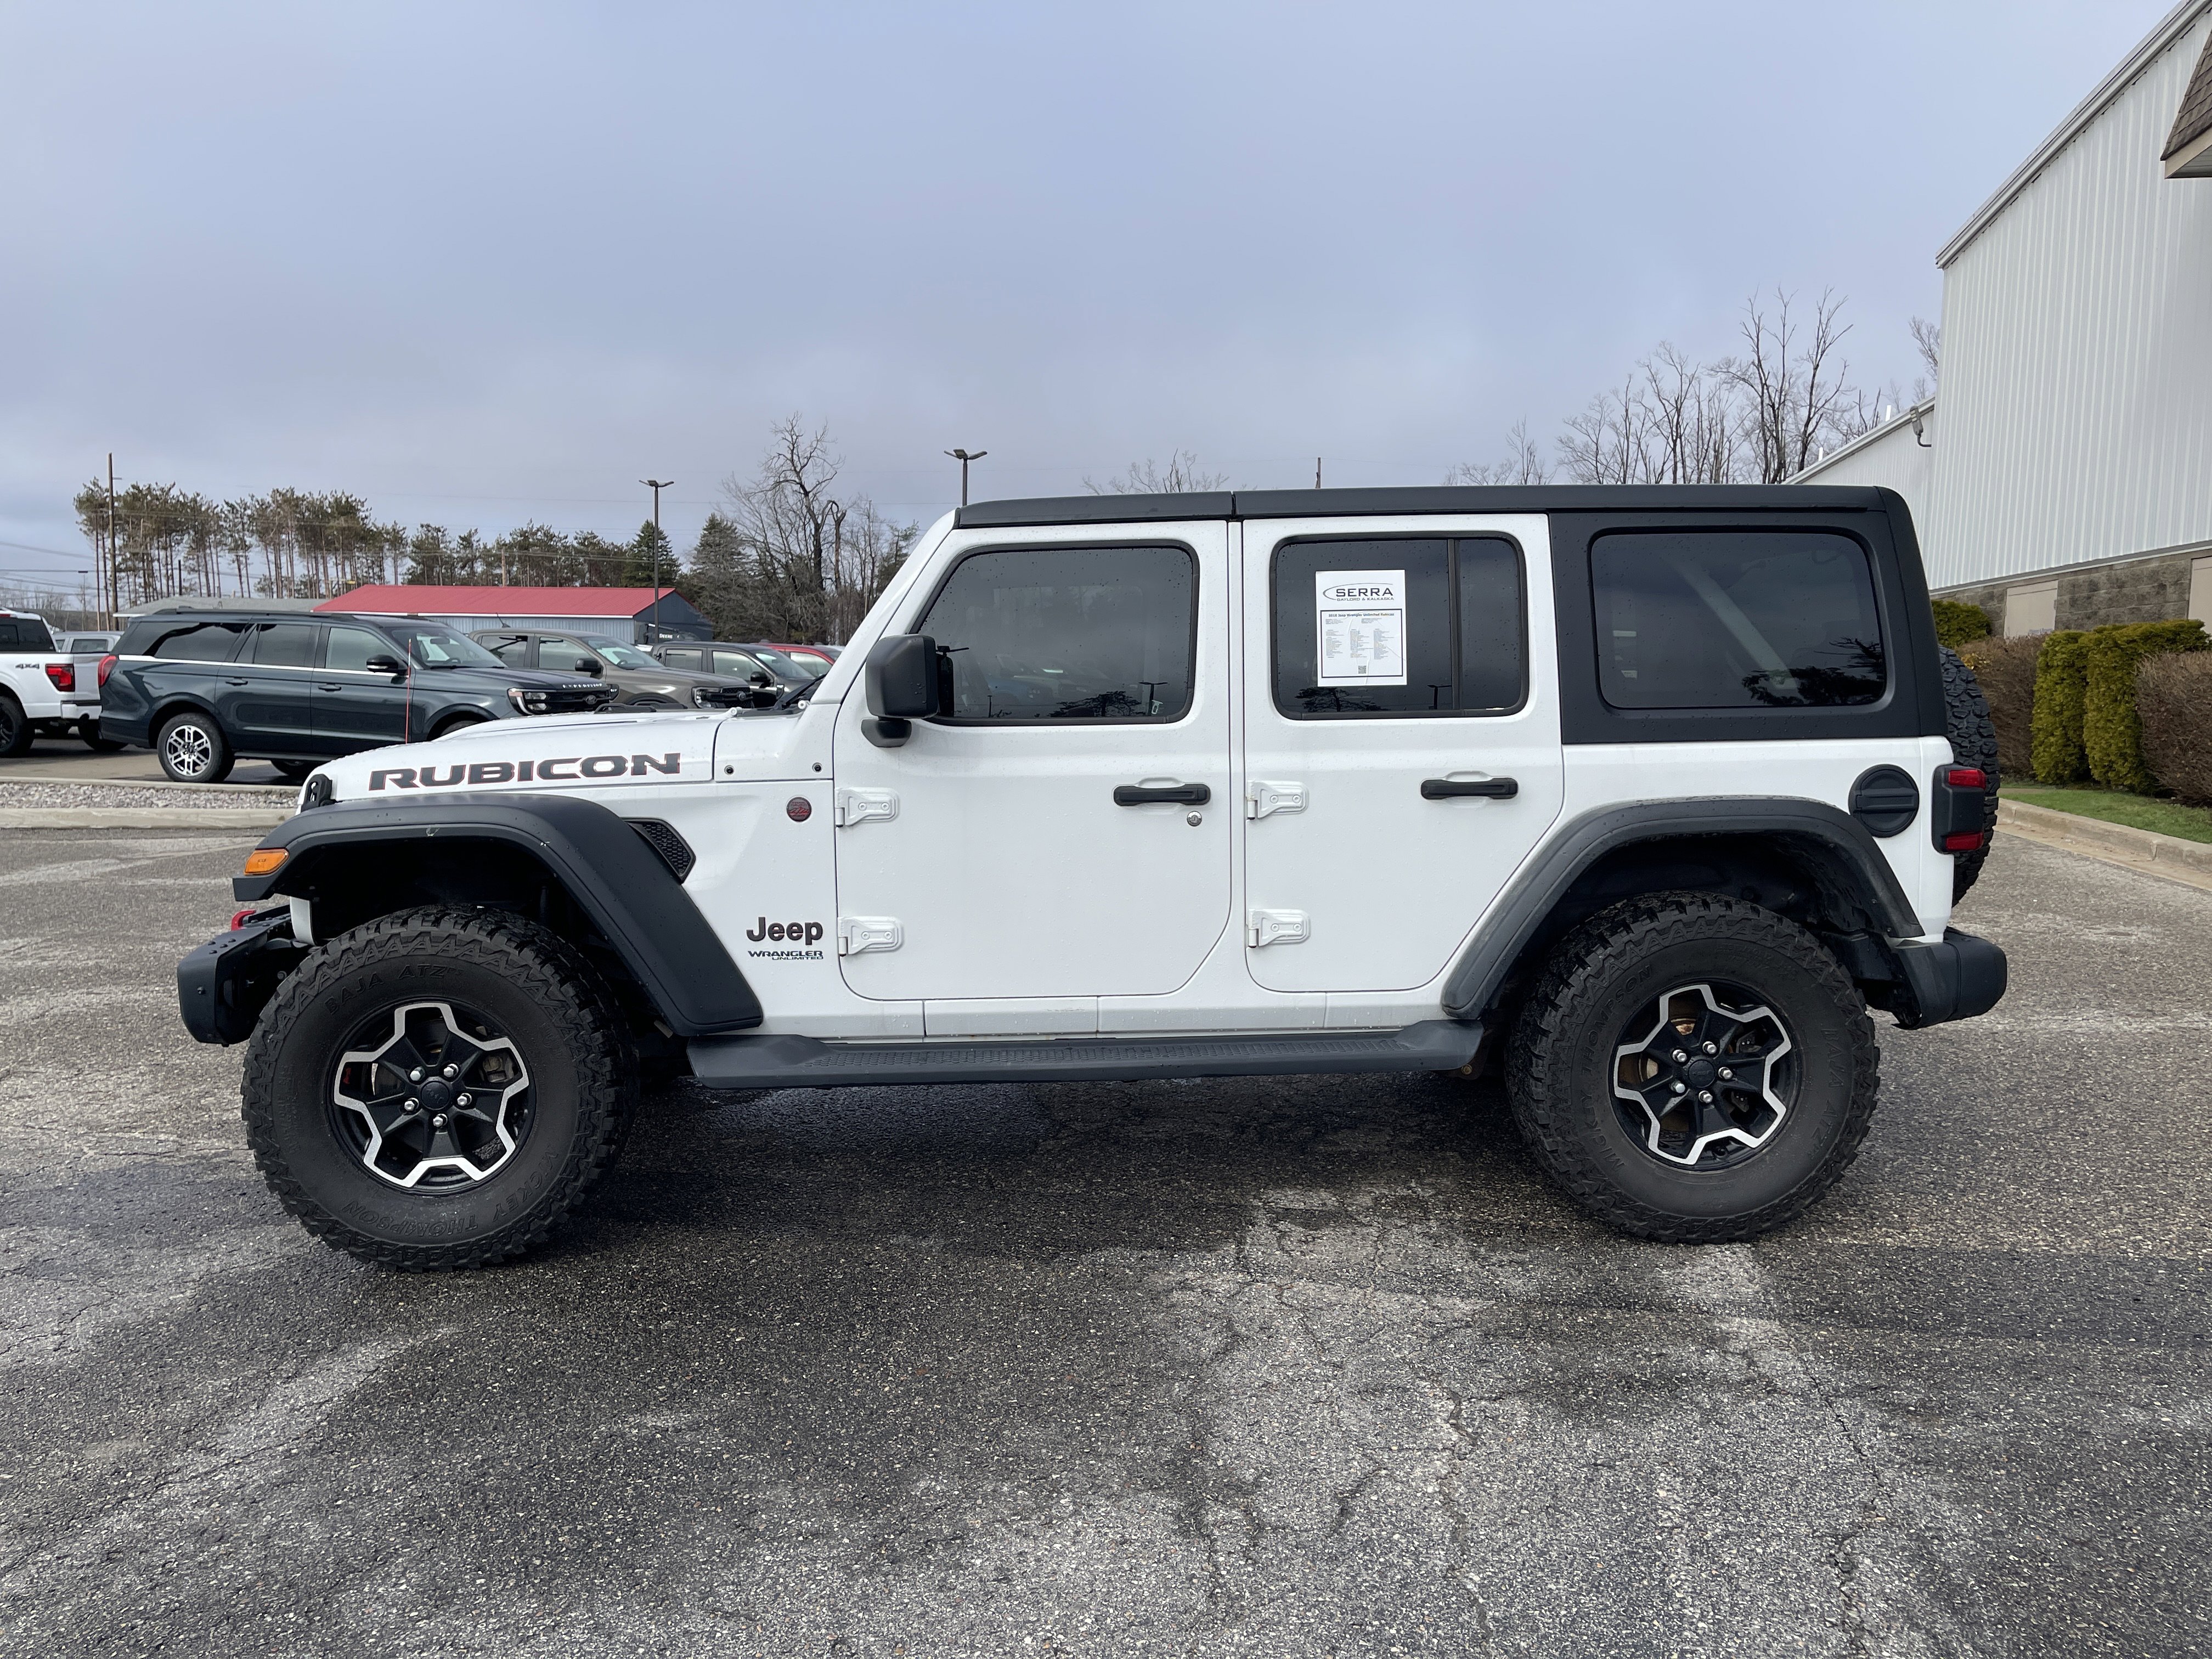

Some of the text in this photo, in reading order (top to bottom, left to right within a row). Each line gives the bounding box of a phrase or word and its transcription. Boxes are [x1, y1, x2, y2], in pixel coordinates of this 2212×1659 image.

[1336, 588, 1393, 597] SERRA
[369, 753, 681, 791] RUBICON
[746, 917, 823, 945] Jeep
[324, 971, 385, 1015] BAJA
[1579, 964, 1653, 1169] MICKEY THOMPSON
[1820, 1029, 1846, 1088] BAJA
[341, 1150, 559, 1237] MICKEY THOMPSON
